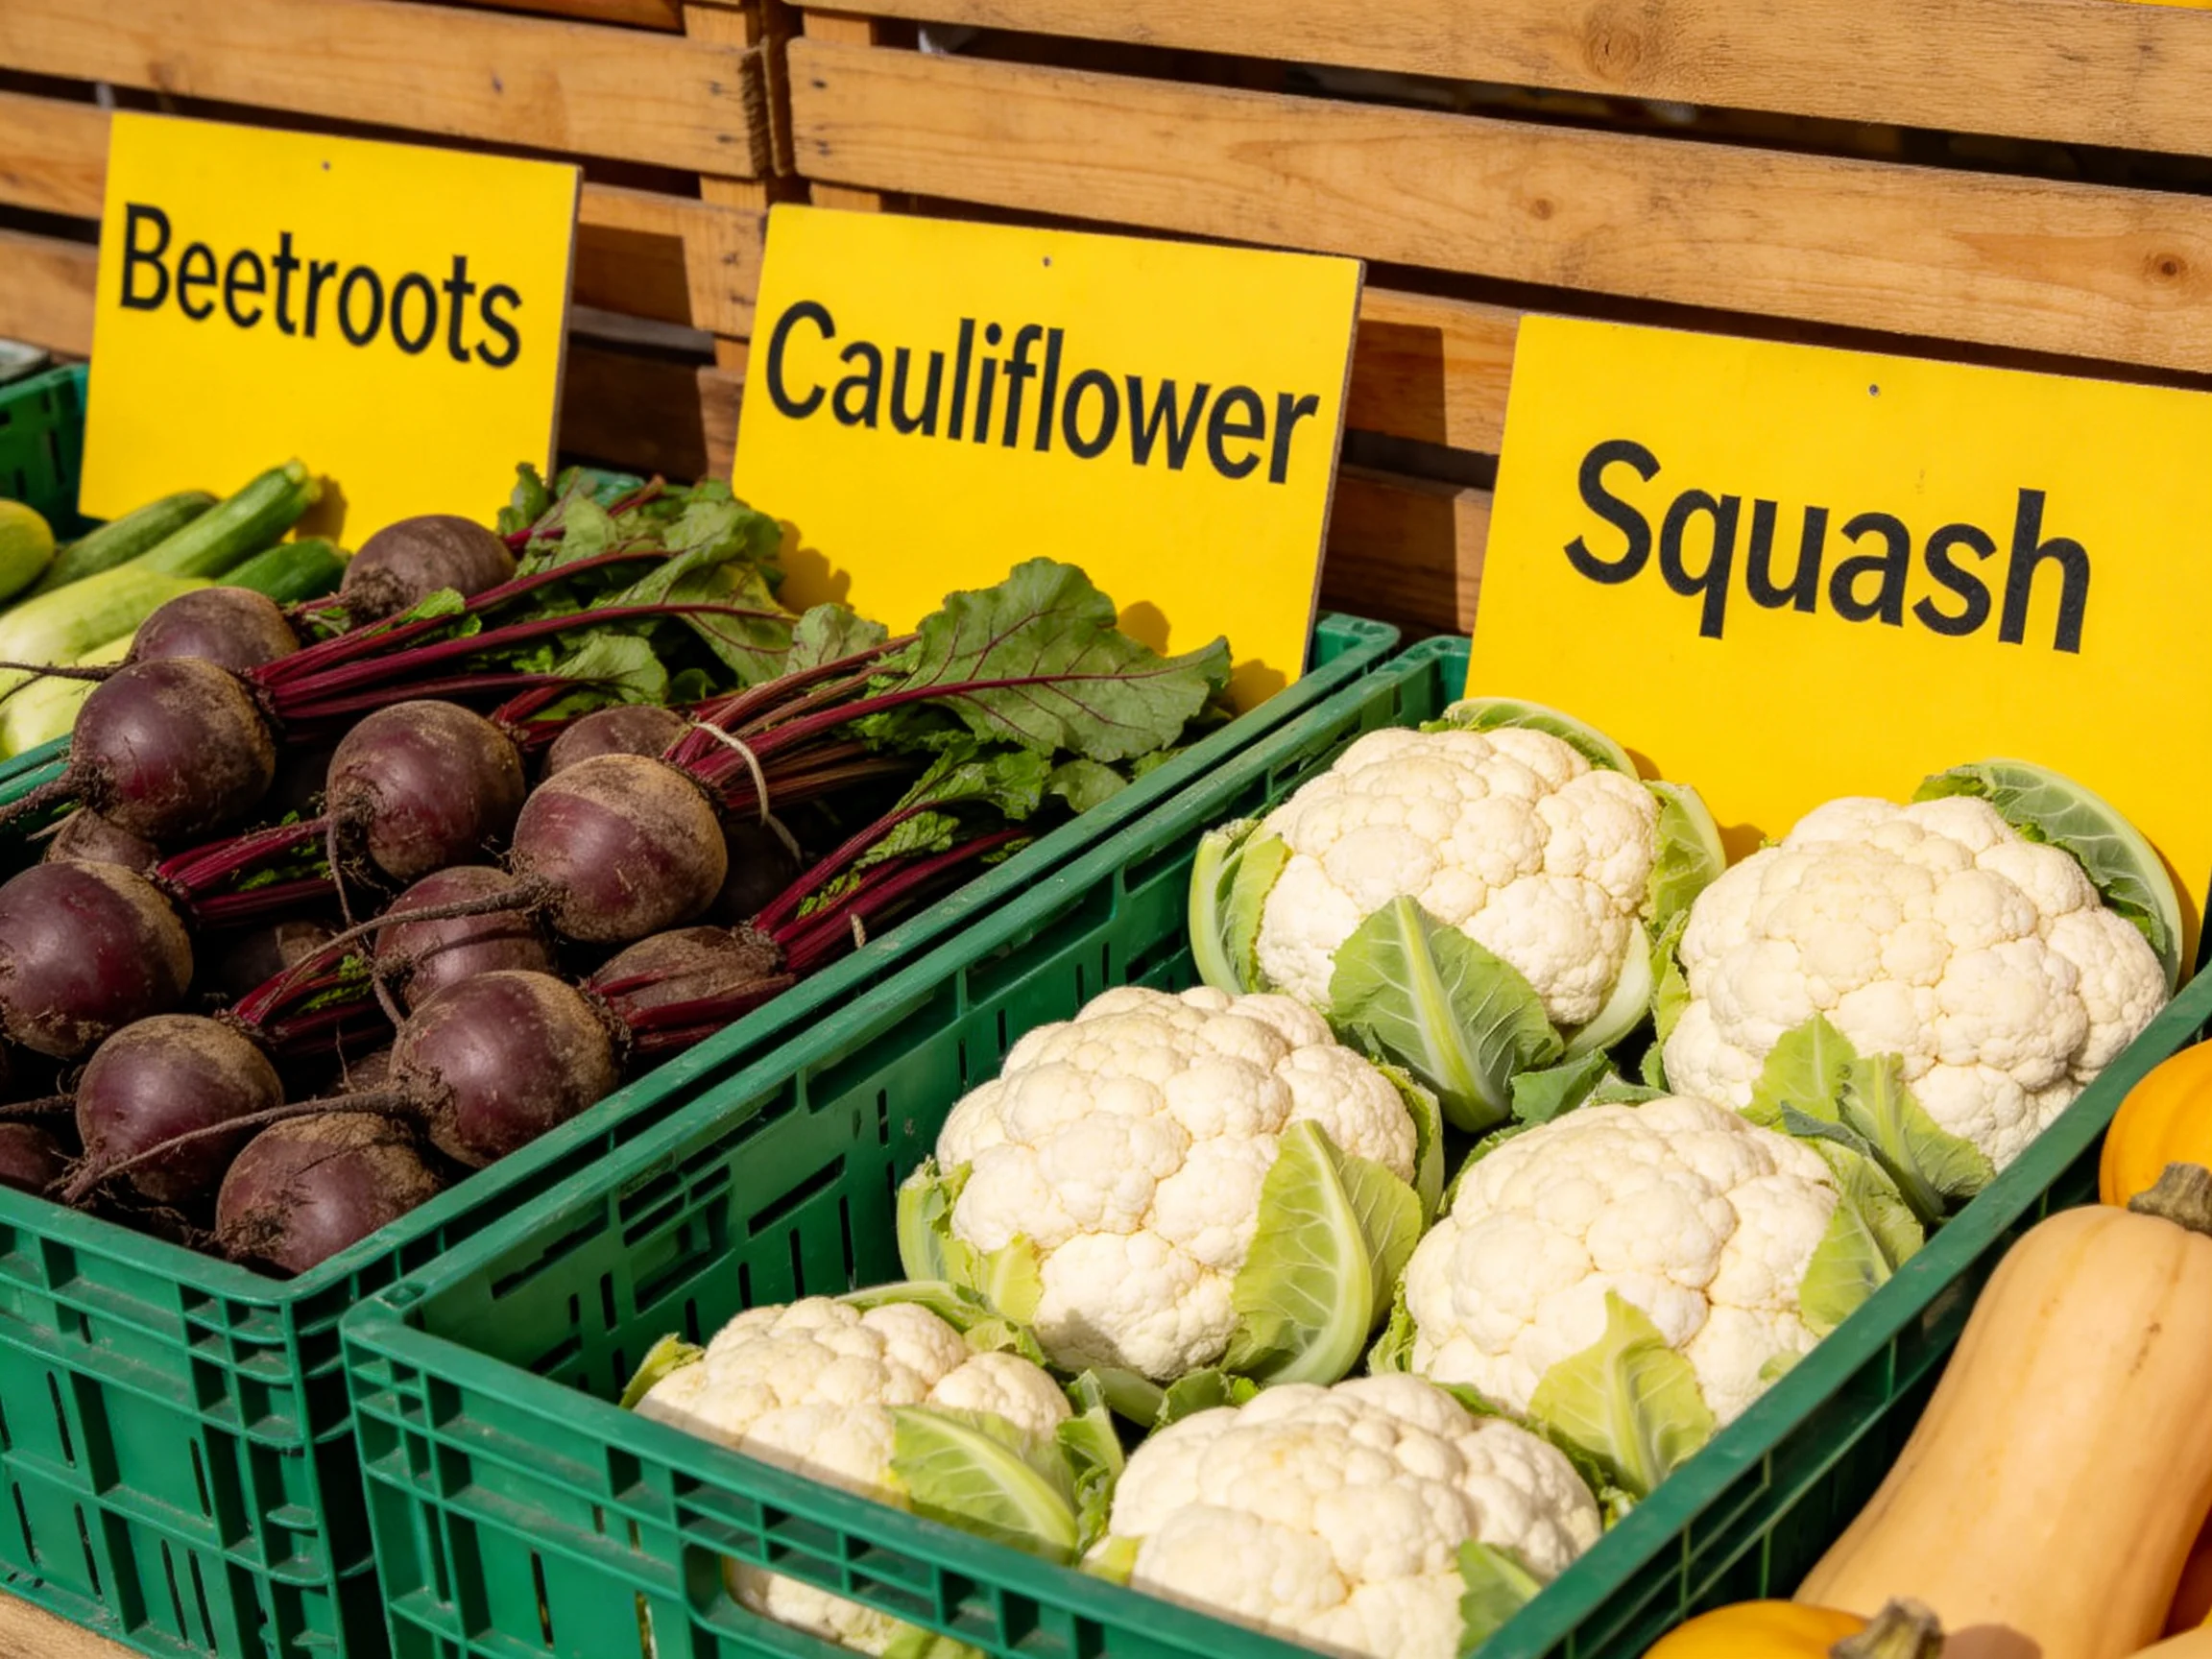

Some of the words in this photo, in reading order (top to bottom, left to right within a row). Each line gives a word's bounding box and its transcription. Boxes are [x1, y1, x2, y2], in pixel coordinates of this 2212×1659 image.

[119, 202, 523, 372] Beetroots
[764, 299, 1320, 486] Cauliflower
[1563, 438, 2092, 655] Squash
